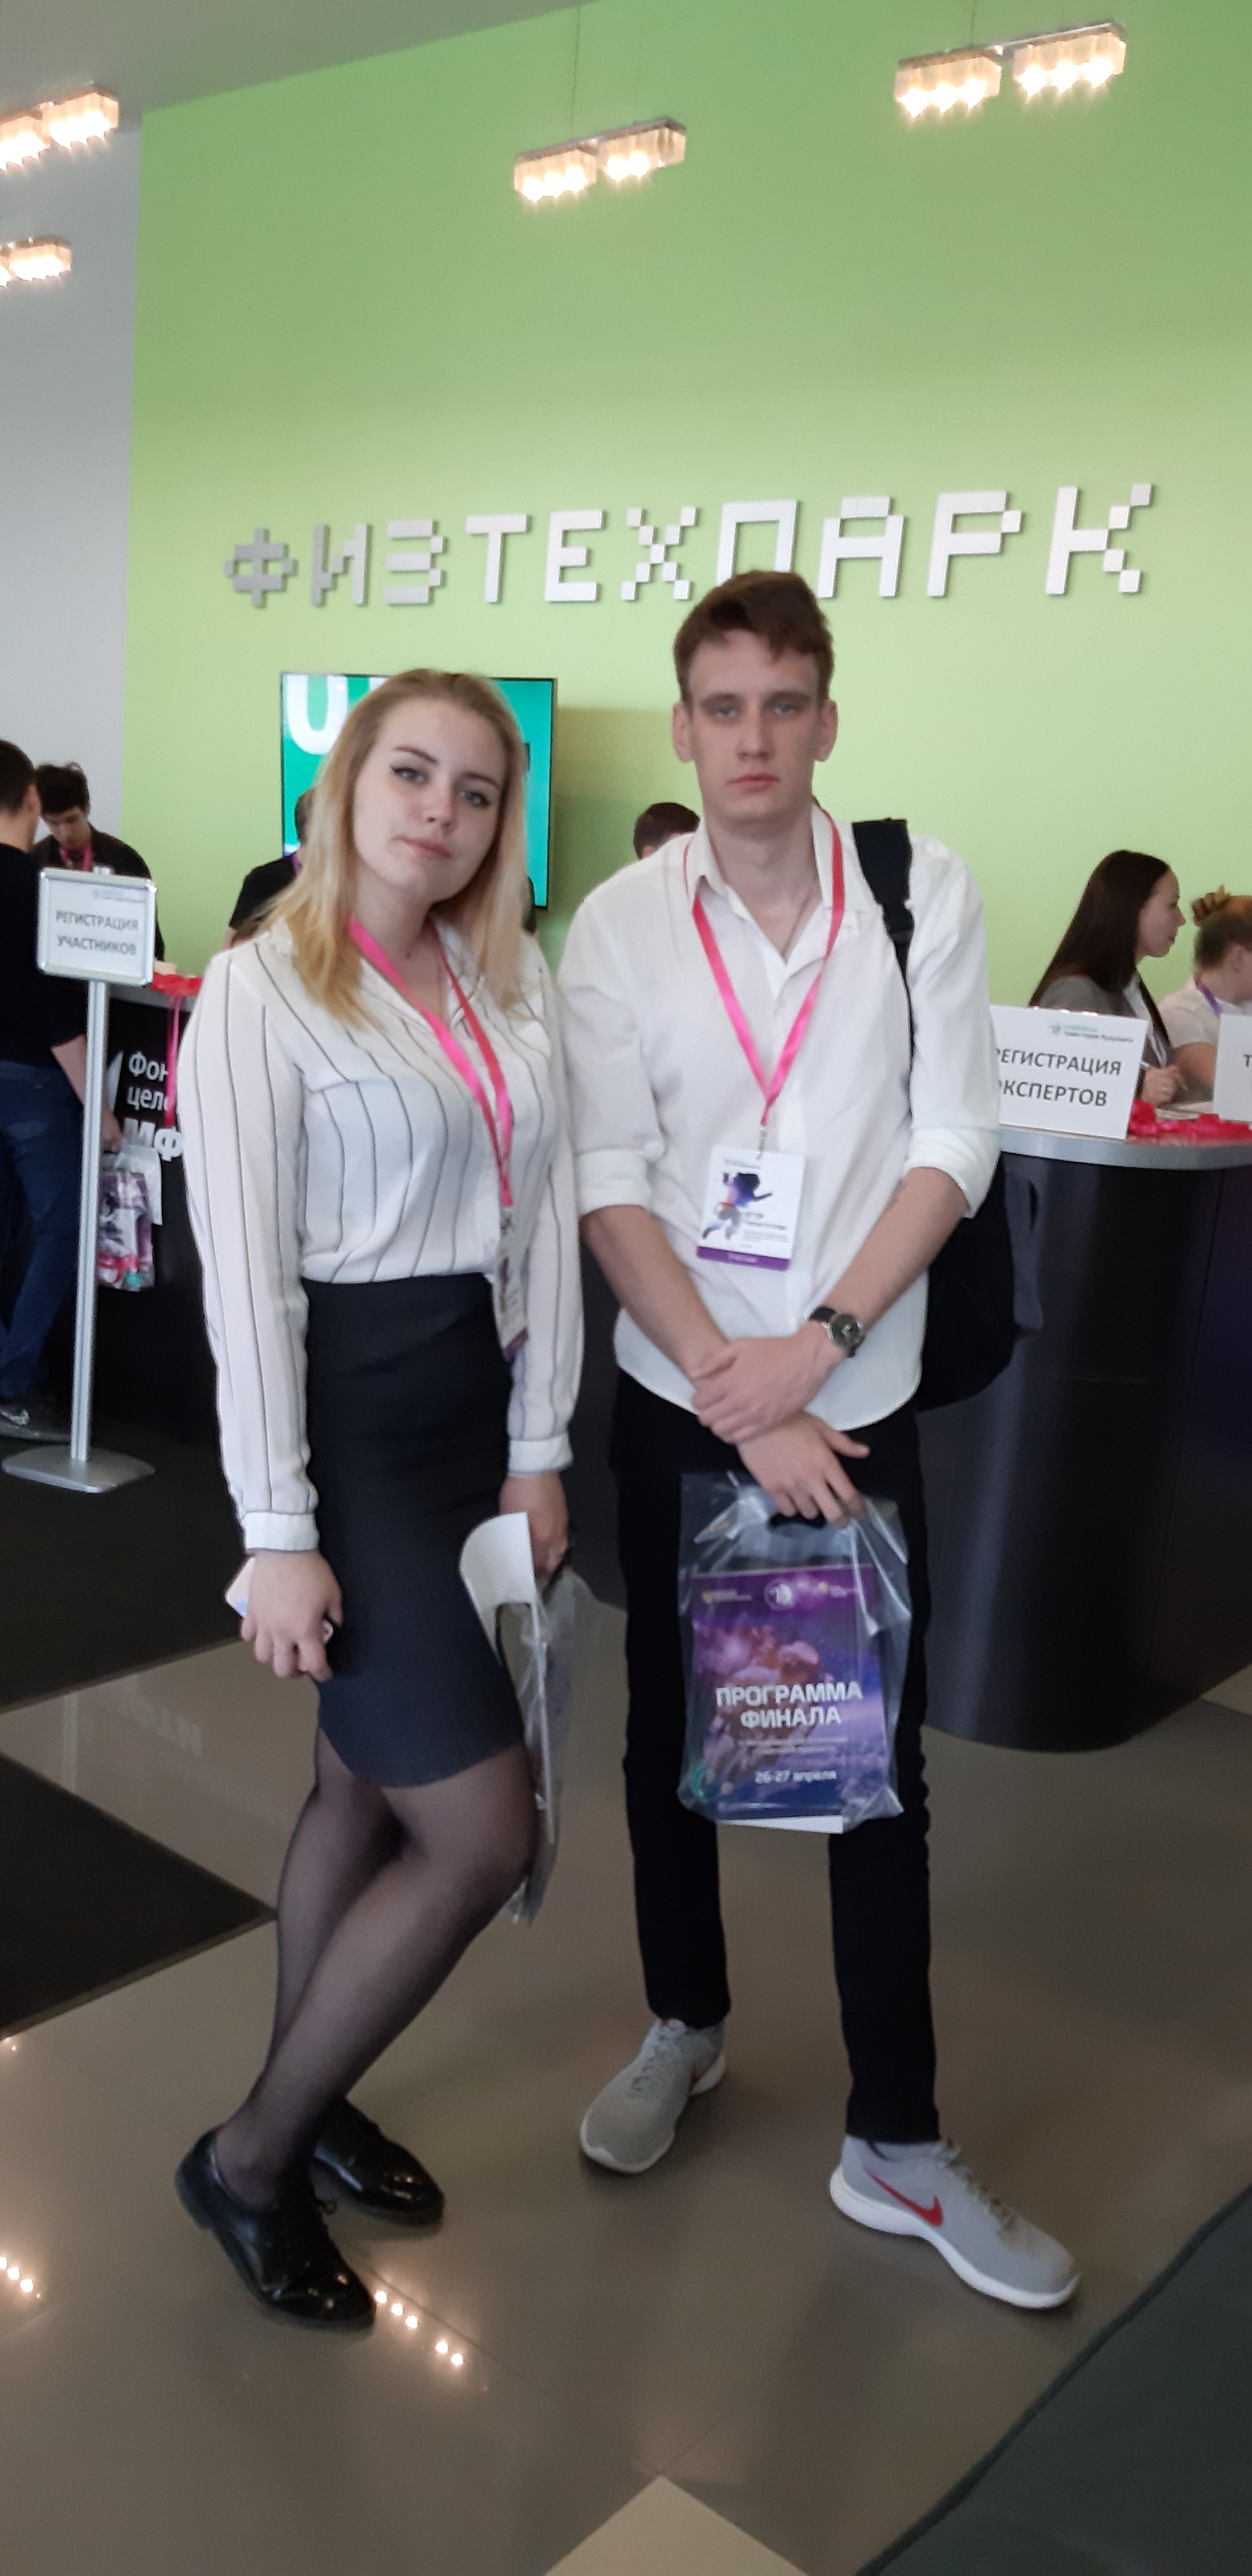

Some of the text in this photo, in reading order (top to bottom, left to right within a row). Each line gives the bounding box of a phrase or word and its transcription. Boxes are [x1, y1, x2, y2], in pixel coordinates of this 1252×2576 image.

[224, 483, 1153, 607] ФИЗТЕХПАРК
[56, 911, 139, 931] РЕГИСТРАЦИЯ
[57, 935, 137, 955] УЧАСТНИКОВ
[996, 1048, 1122, 1076] ЕГИСТРАЦИЯ
[999, 1079, 1107, 1107] КСПЕРТОВ
[716, 1681, 863, 1706] ПРОГРАММА
[740, 1706, 841, 1728] ФИНАЛА
